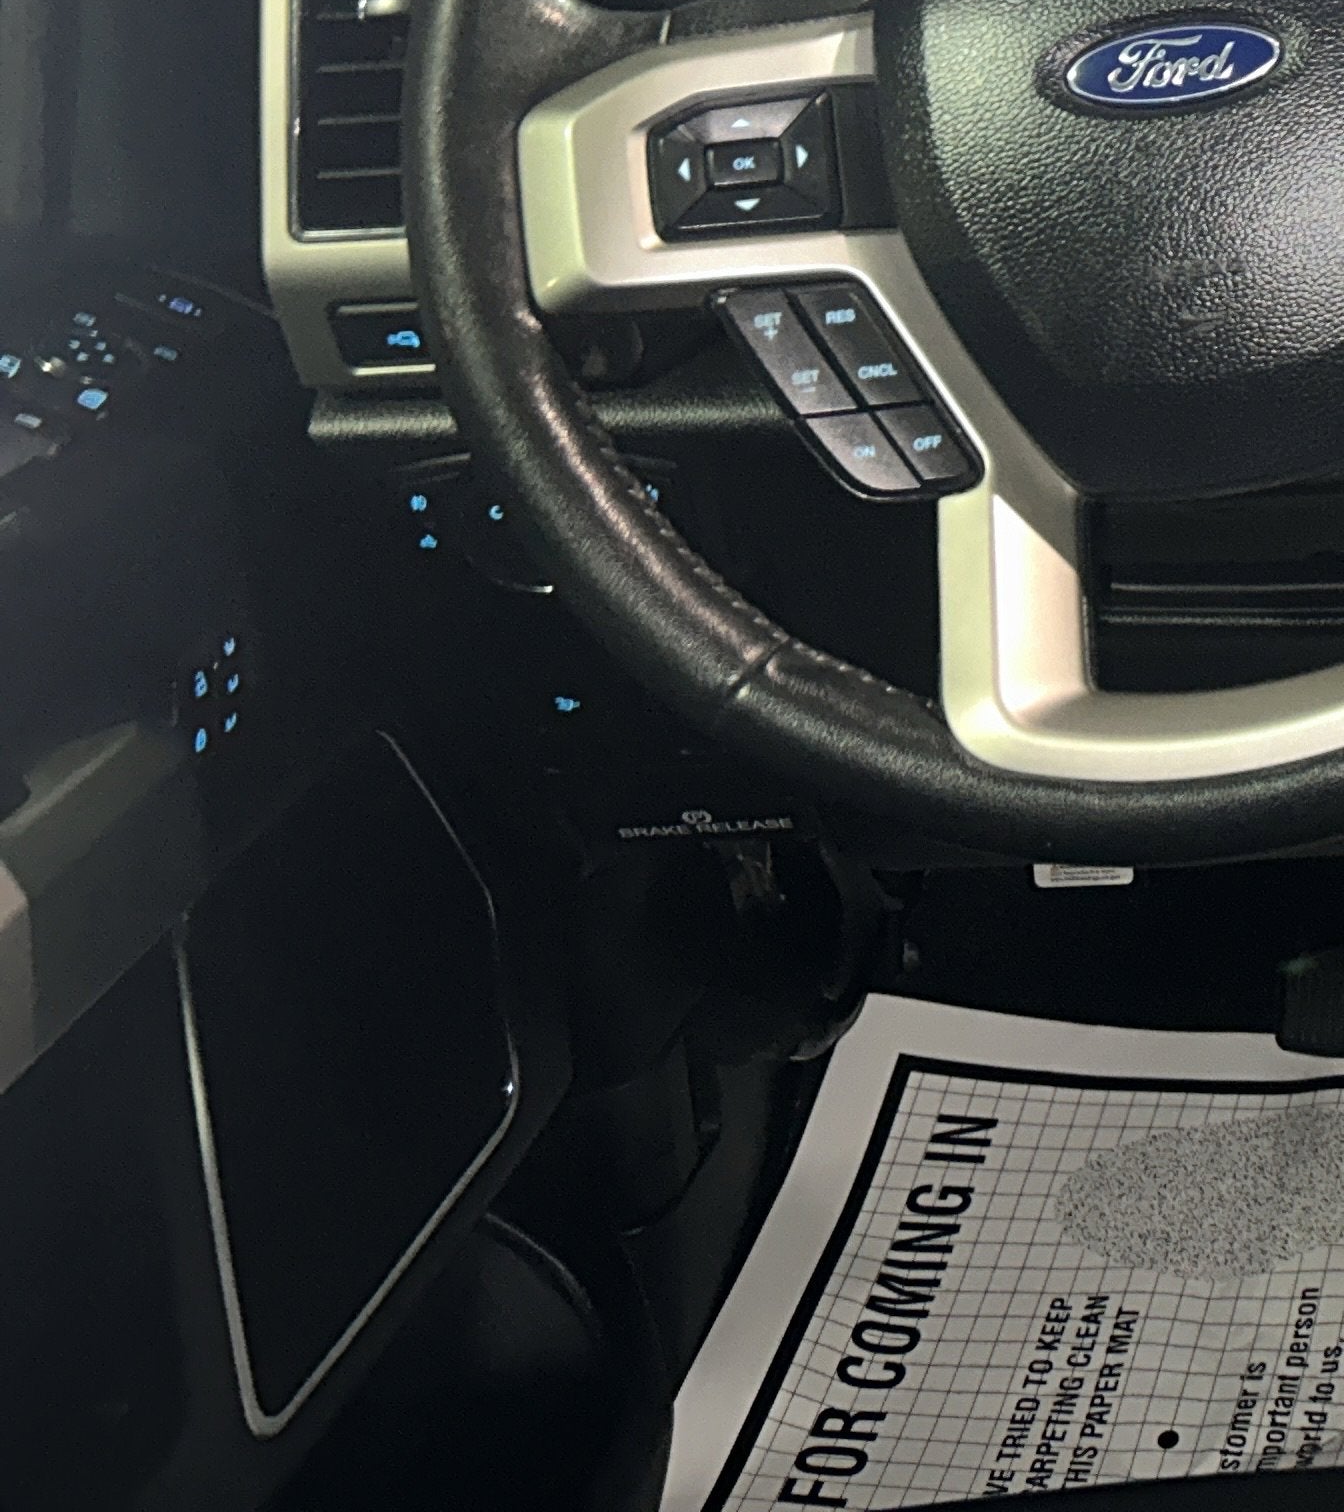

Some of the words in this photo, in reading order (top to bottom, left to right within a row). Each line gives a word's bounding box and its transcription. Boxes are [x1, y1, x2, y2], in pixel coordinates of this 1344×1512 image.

[1107, 34, 1236, 93] Ford
[732, 156, 755, 171] OK
[754, 311, 782, 329] SET
[825, 308, 856, 325] RES
[792, 368, 820, 386] SET
[853, 445, 876, 459] ON
[913, 434, 942, 451] OFF
[618, 824, 692, 839] BRAKE
[695, 818, 794, 834] RELEASE
[778, 1406, 888, 1510] FOR
[836, 1183, 975, 1388] COMING
[924, 1113, 999, 1164] IN
[1035, 1297, 1073, 1352] KEEP
[1066, 1295, 1110, 1368] CLEAN
[1286, 1287, 1320, 1368] person
[1022, 1358, 1054, 1389] TO
[1080, 1362, 1124, 1439] PAPER
[1105, 1305, 1140, 1354] MAT
[1240, 1361, 1267, 1381] is
[1309, 1382, 1335, 1404] to
[995, 1396, 1041, 1463] TRIED
